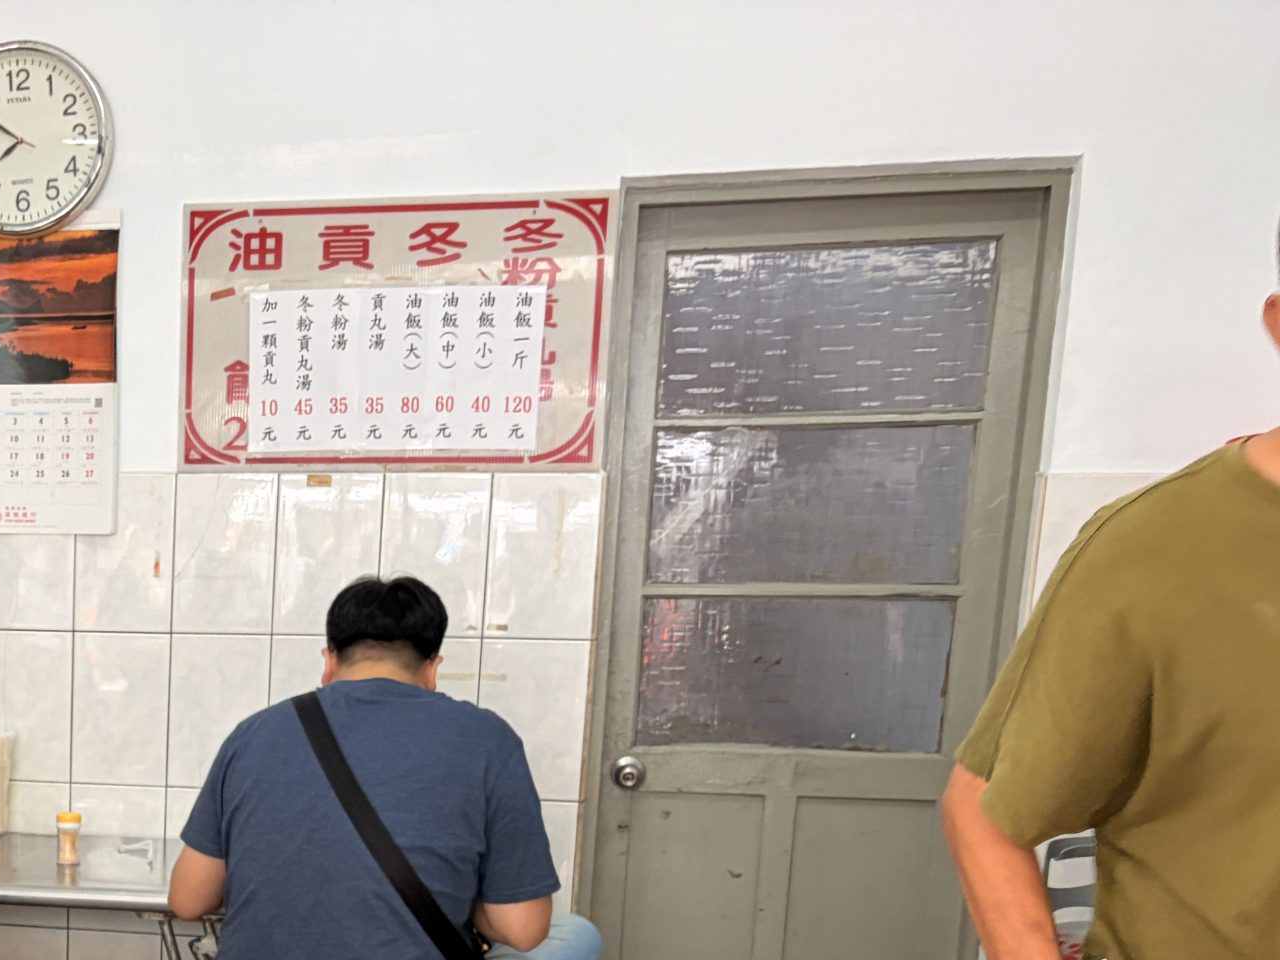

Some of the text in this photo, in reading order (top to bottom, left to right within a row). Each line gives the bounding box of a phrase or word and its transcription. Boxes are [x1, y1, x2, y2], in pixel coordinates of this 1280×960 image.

[6, 69, 30, 92] 12
[46, 74, 53, 96] 1
[62, 94, 77, 116] 2
[72, 123, 88, 146] 3
[64, 155, 79, 177] 4
[45, 178, 60, 200] 5
[15, 190, 30, 212] 6
[228, 227, 283, 272] 油
[318, 224, 375, 271] 貢
[408, 222, 468, 268] 冬
[261, 297, 278, 442] 加一顆貢丸 10 元
[294, 295, 314, 441] 冬粉貢丸湯 45 元
[329, 293, 349, 440] 冬粉湯 35 元
[365, 293, 387, 440] 貢丸湯 35 元
[505, 291, 533, 439] 油飯一斤 120 元
[401, 396, 420, 414] 80
[435, 395, 454, 413] 60
[471, 395, 491, 413] 40
[401, 424, 418, 439] 元
[436, 423, 452, 438] 元
[471, 423, 488, 439] 元
